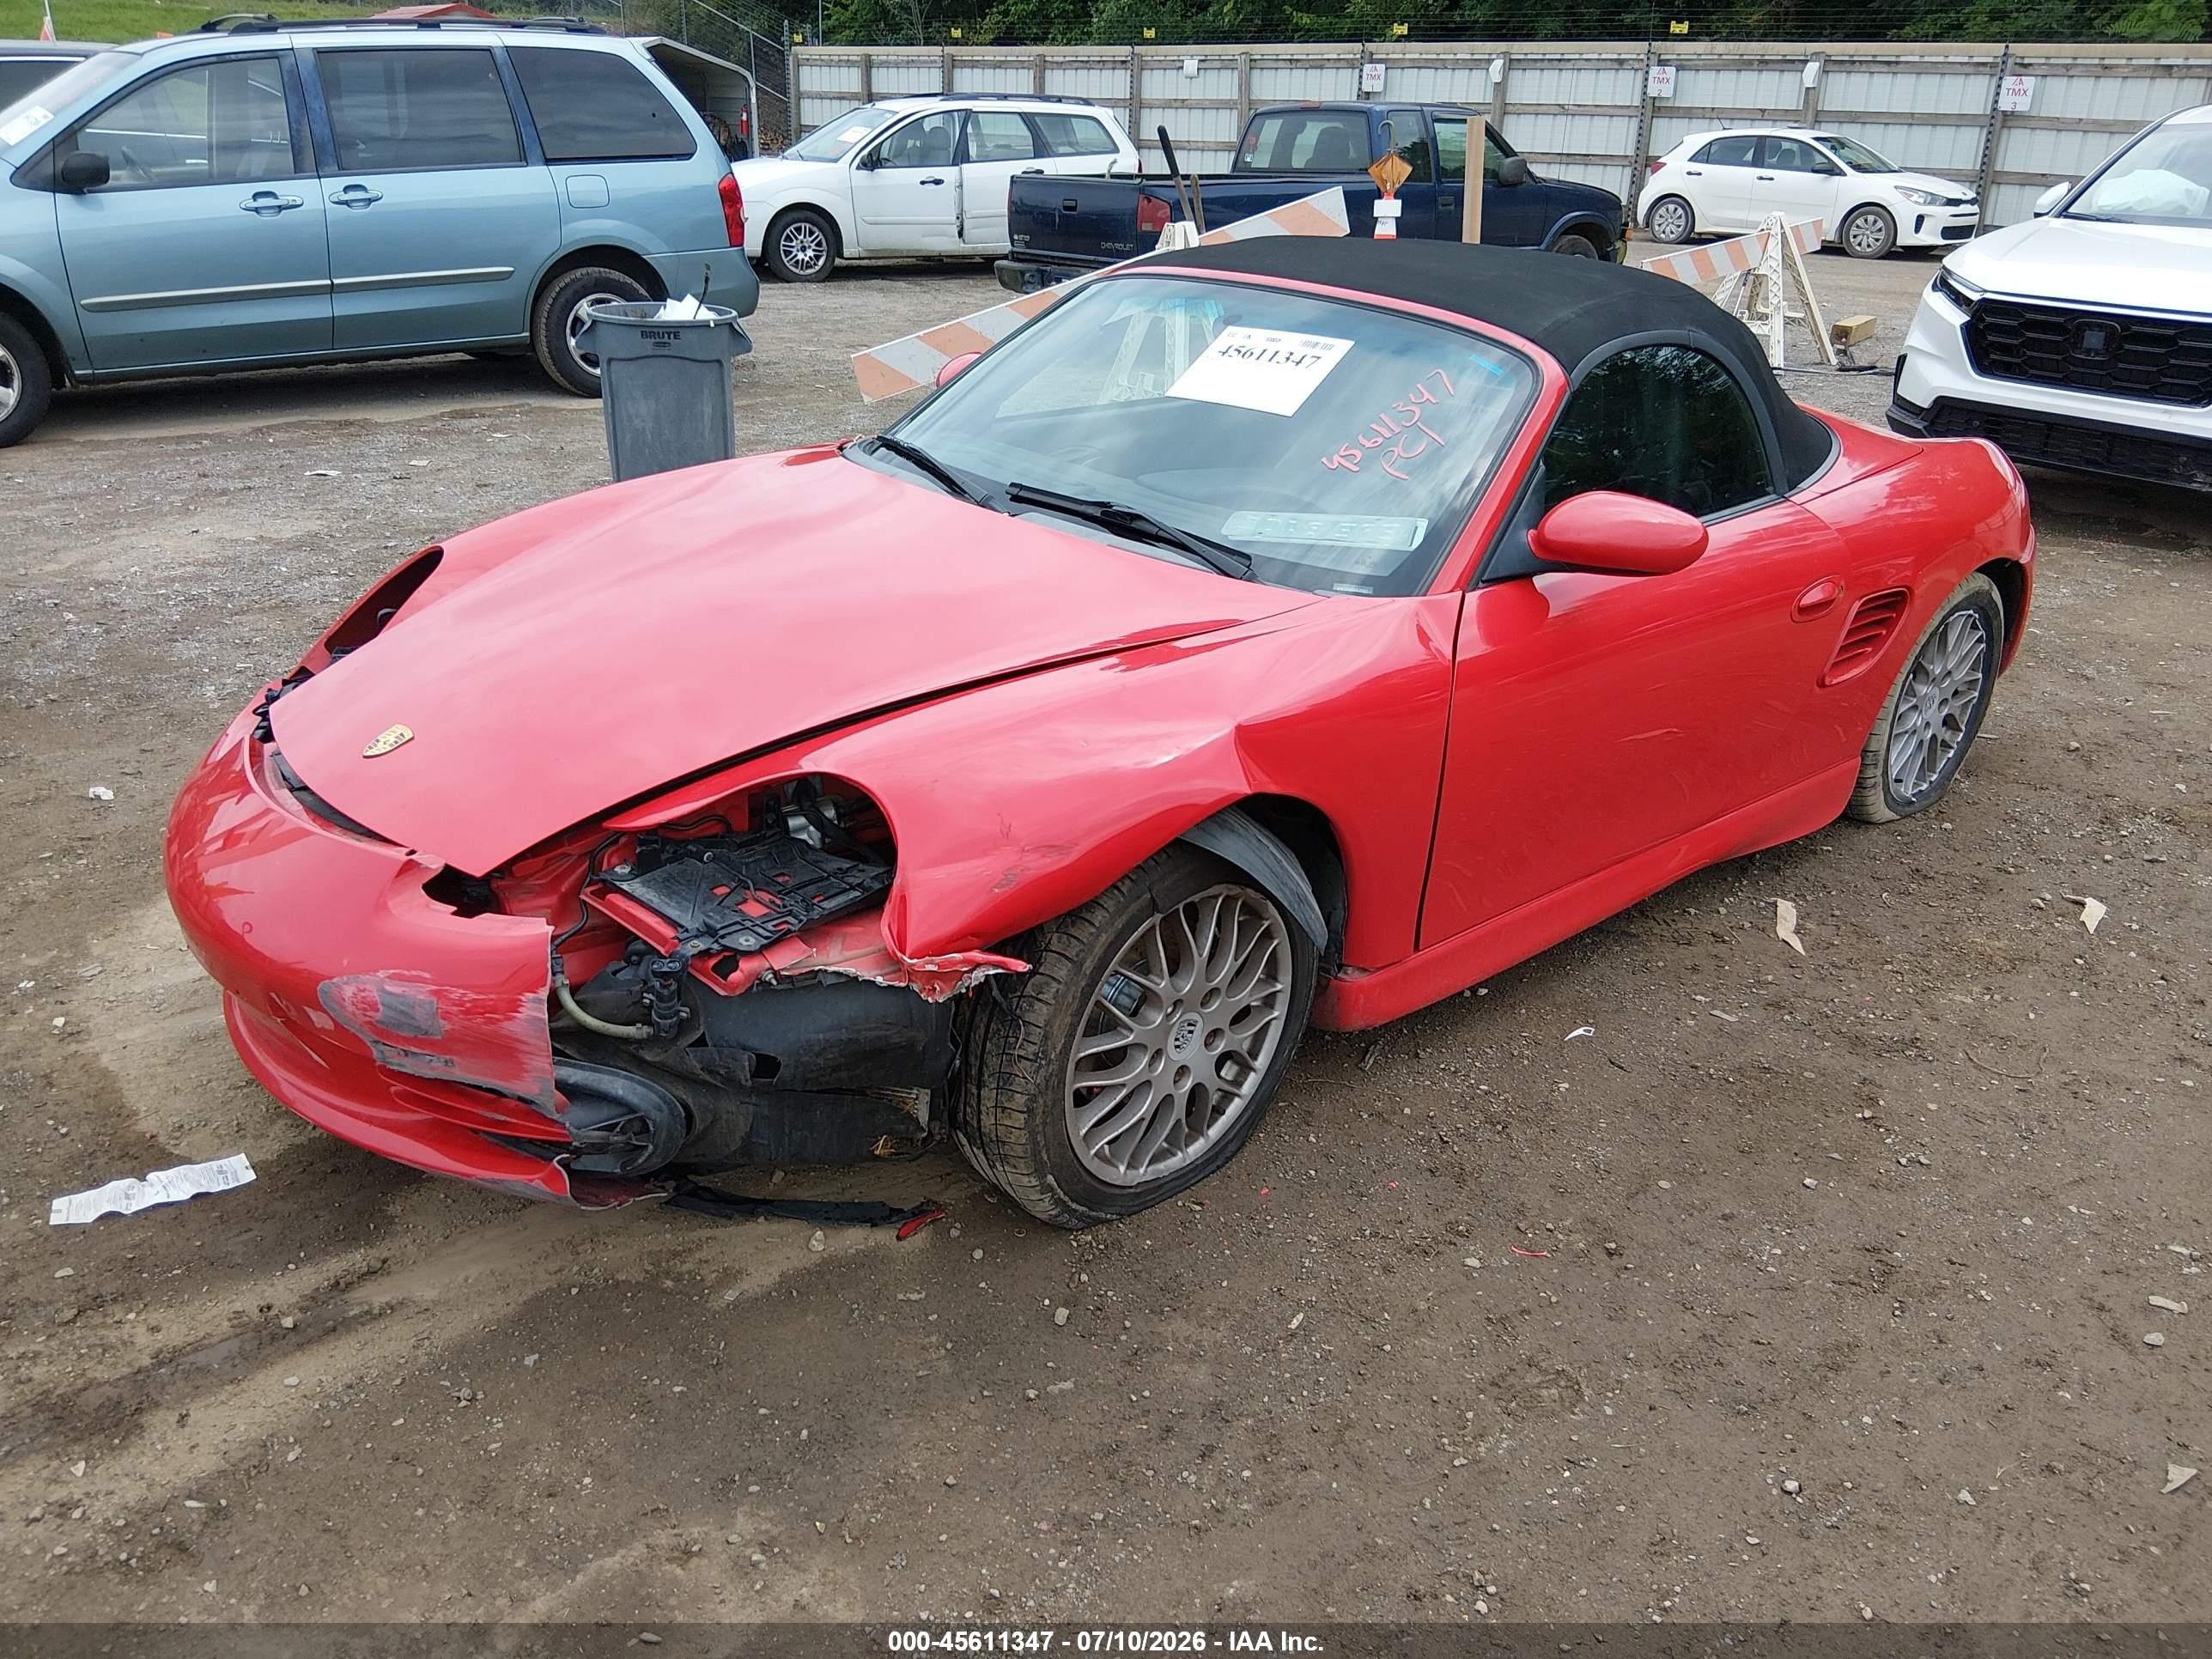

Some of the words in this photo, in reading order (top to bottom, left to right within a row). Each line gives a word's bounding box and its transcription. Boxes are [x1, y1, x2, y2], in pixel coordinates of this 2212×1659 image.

[1366, 73, 1382, 82] TMX
[1652, 76, 1671, 85] TMX
[2005, 88, 2028, 97] TMX
[2010, 101, 2018, 110] 3
[1100, 241, 1134, 252] CHEVROLET
[640, 330, 682, 341] BRUTE
[1218, 343, 1322, 369] 45611347
[1321, 368, 1455, 472] 45611347
